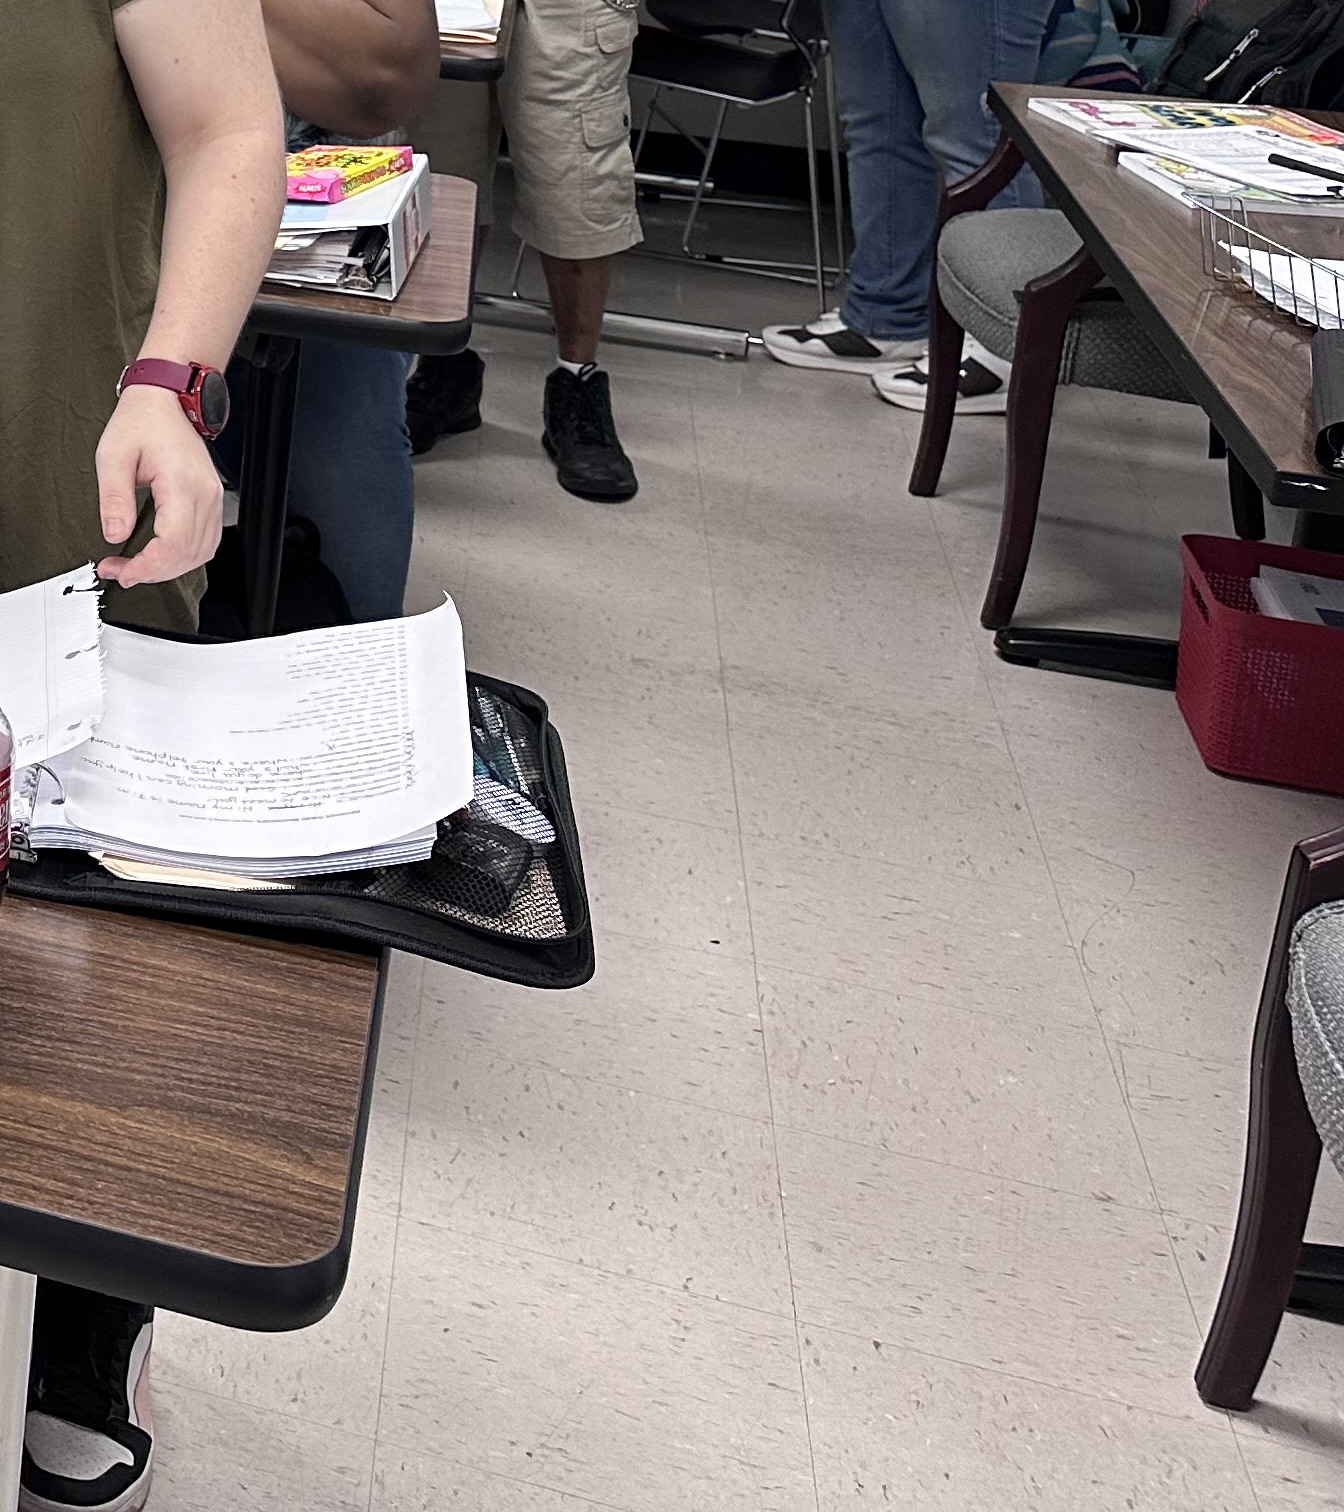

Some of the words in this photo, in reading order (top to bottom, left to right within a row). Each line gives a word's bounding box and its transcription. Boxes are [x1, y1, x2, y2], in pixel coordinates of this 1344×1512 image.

[298, 183, 322, 192] HEARTS
[131, 754, 178, 768] name
[146, 776, 172, 786] can
[167, 798, 206, 810] name
[212, 801, 233, 812] my
